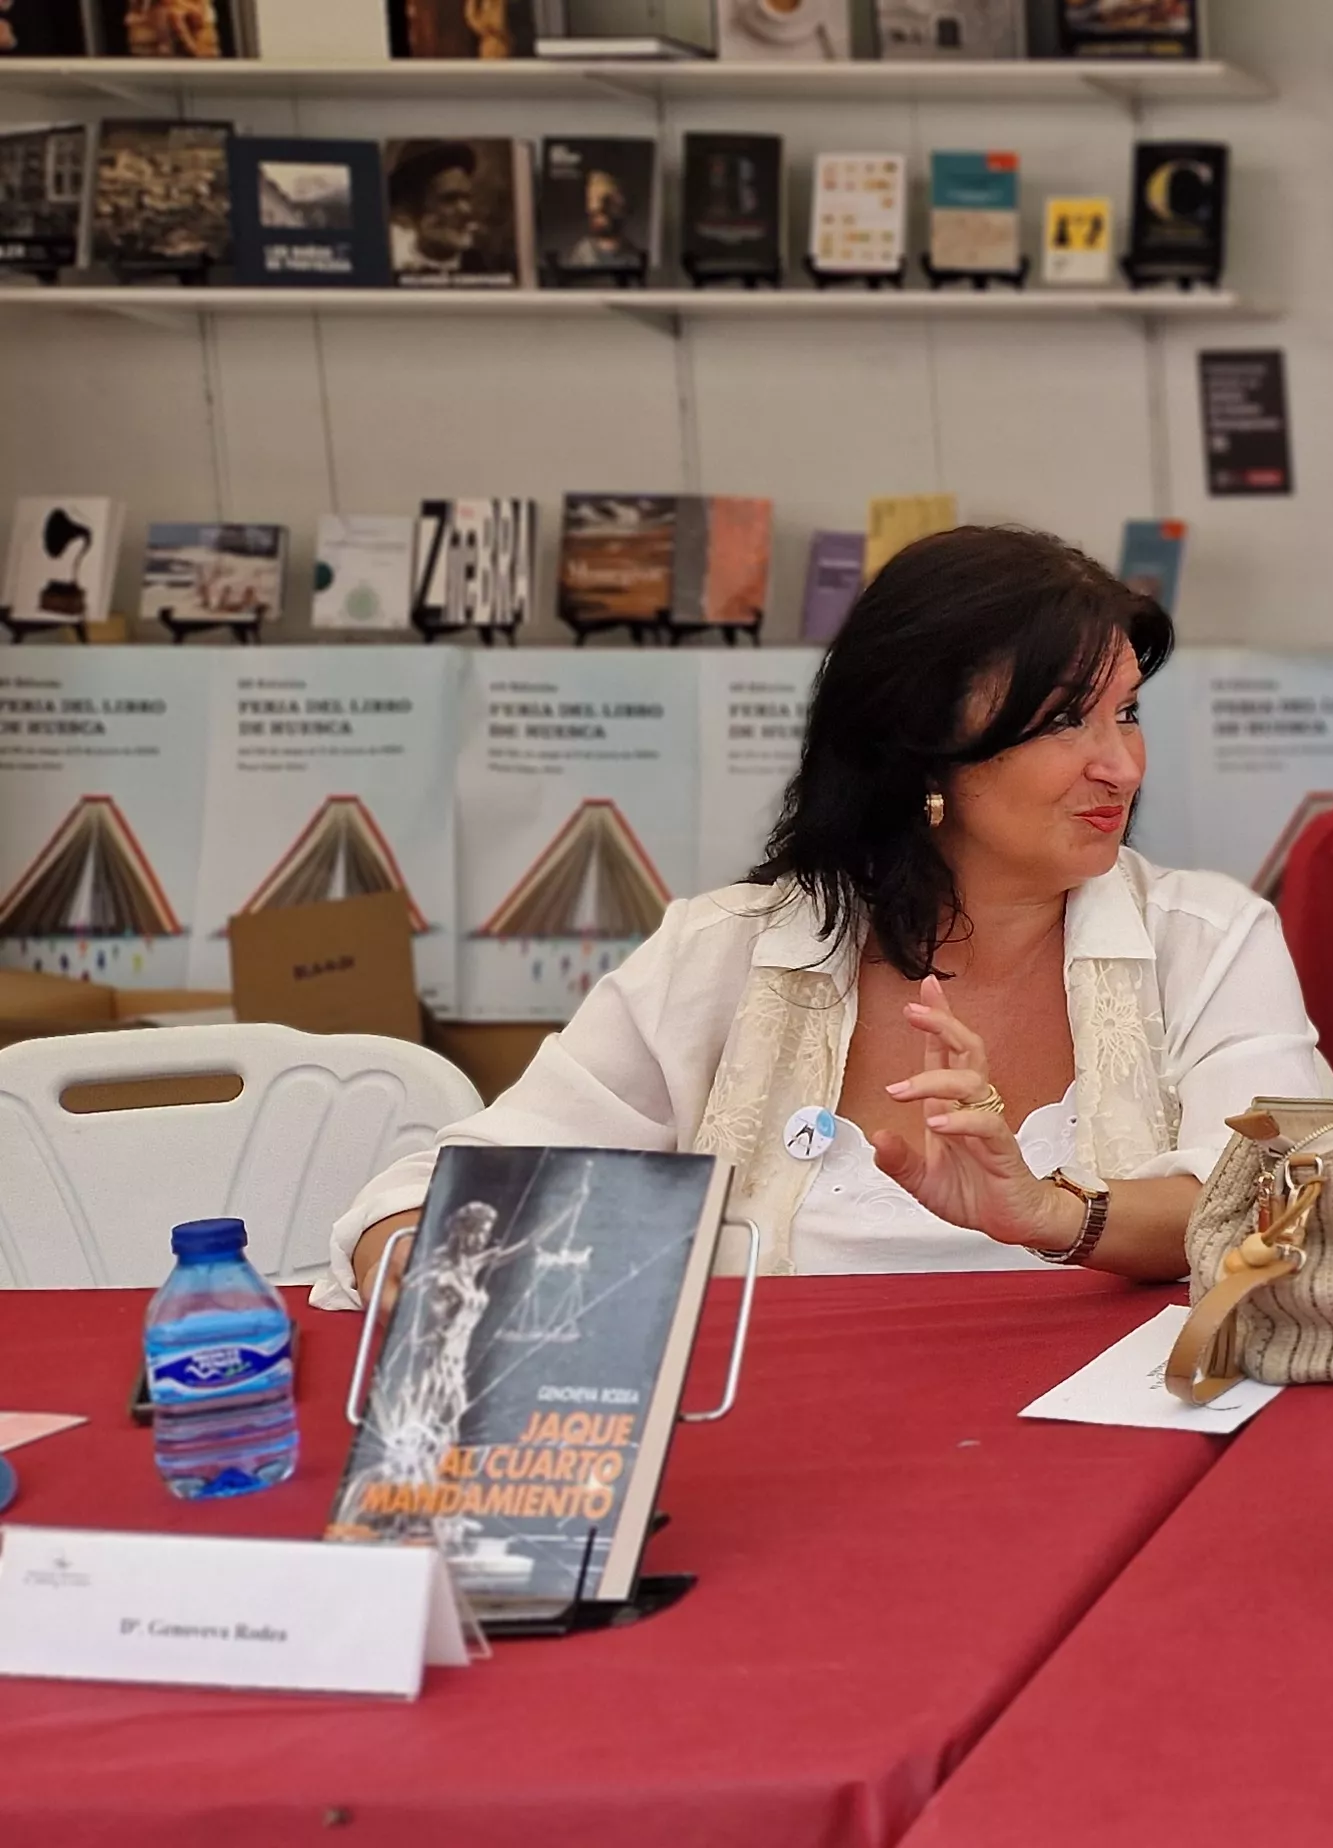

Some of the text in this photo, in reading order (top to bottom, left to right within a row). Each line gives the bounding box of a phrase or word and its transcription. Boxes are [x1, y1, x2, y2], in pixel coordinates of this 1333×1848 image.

[0, 698, 168, 715] ERIA DEL LIBRO
[238, 698, 413, 715] FERIA DEL LIBRO
[489, 702, 665, 719] FERIA DEL LIBRO
[27, 720, 106, 736] HUESCA
[238, 721, 353, 736] DE HUESCA
[488, 724, 607, 740] DE HUESCA
[537, 1384, 598, 1403] GENOVEVA
[519, 1411, 637, 1447] JAQUE
[438, 1445, 623, 1484] AL CUARTO
[361, 1482, 614, 1520] MANDAMIENTO
